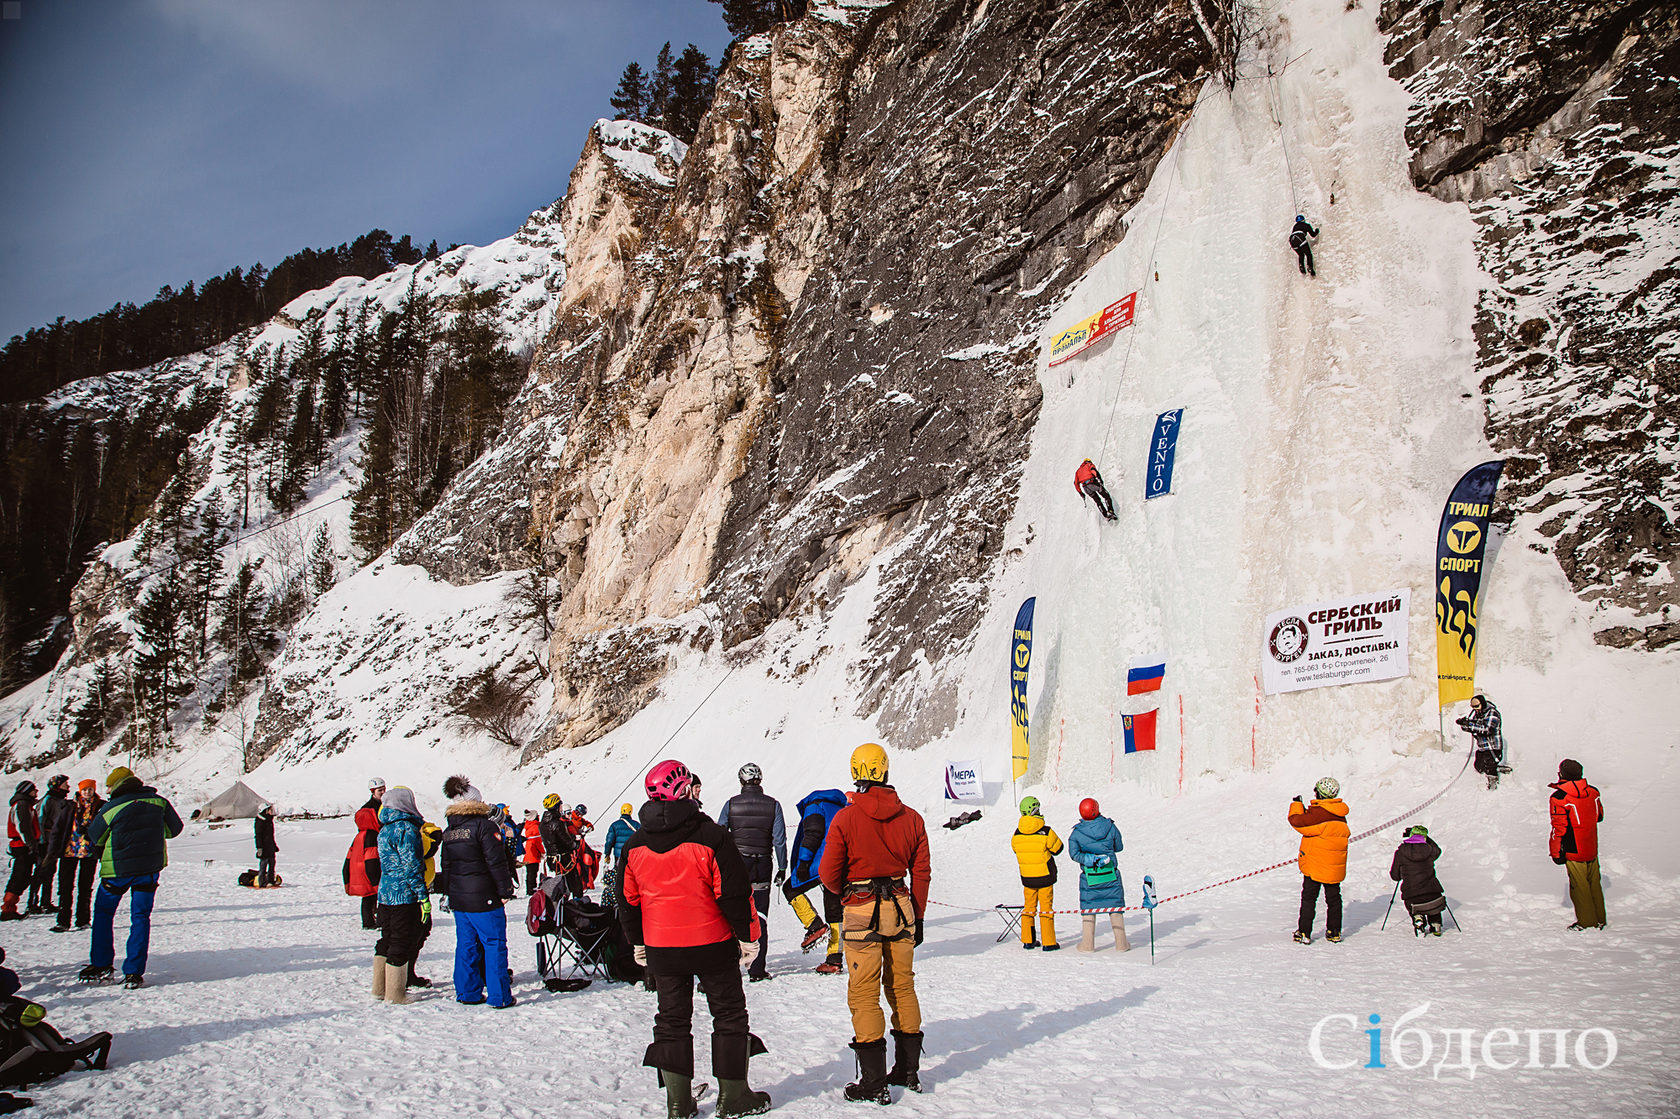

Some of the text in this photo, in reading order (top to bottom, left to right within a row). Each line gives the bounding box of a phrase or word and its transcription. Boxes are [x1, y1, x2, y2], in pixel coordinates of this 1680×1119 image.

[1152, 424, 1172, 492] VENTO
[1449, 501, 1489, 517] ТРИАЛ
[1440, 557, 1481, 573] СПОРТ
[1307, 595, 1402, 625] СЕРБСКИЙ
[1277, 617, 1300, 629] ТЕСЛА
[1324, 616, 1383, 637] ГРИЛЬ
[1274, 648, 1303, 662] БУРГЕР
[1308, 640, 1399, 661] ЗАКАЗ, ДОСТАВКА
[1294, 664, 1319, 674] 765-063
[1321, 662, 1333, 670] б-р
[1380, 654, 1389, 662] 26
[1296, 667, 1371, 682] www.teslaburger.com
[954, 769, 976, 780] МЕРА
